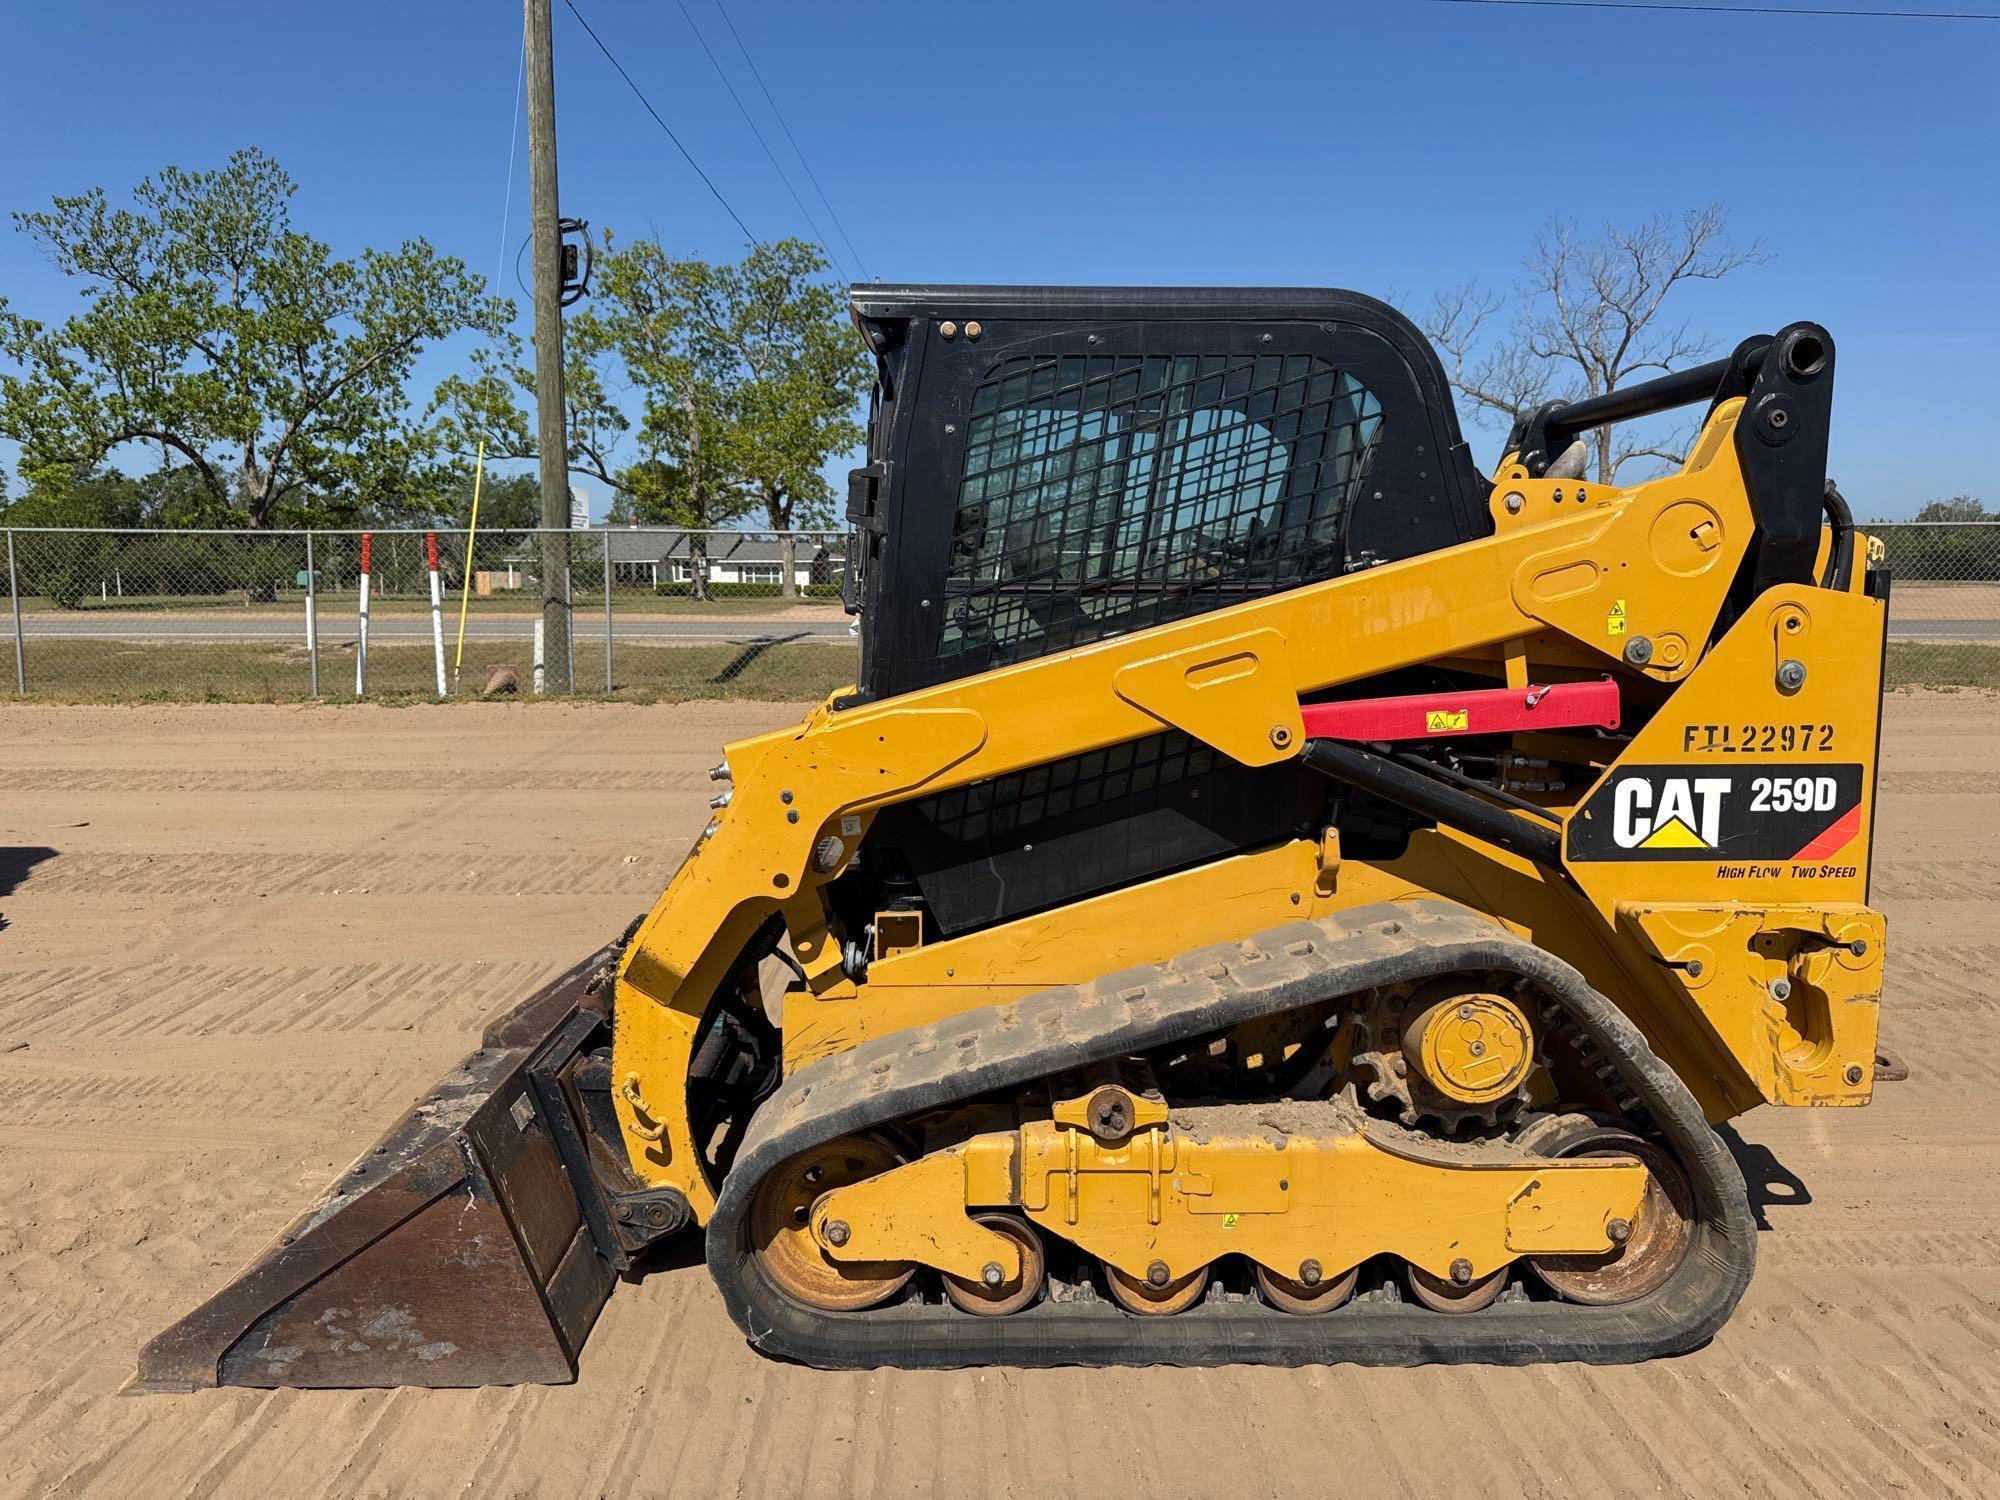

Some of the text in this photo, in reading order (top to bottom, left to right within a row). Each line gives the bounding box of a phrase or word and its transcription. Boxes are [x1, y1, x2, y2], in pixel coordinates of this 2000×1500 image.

[1683, 725, 1834, 753] FTL22972
[1750, 777, 1837, 812] 259D
[1612, 777, 1731, 849] CAT
